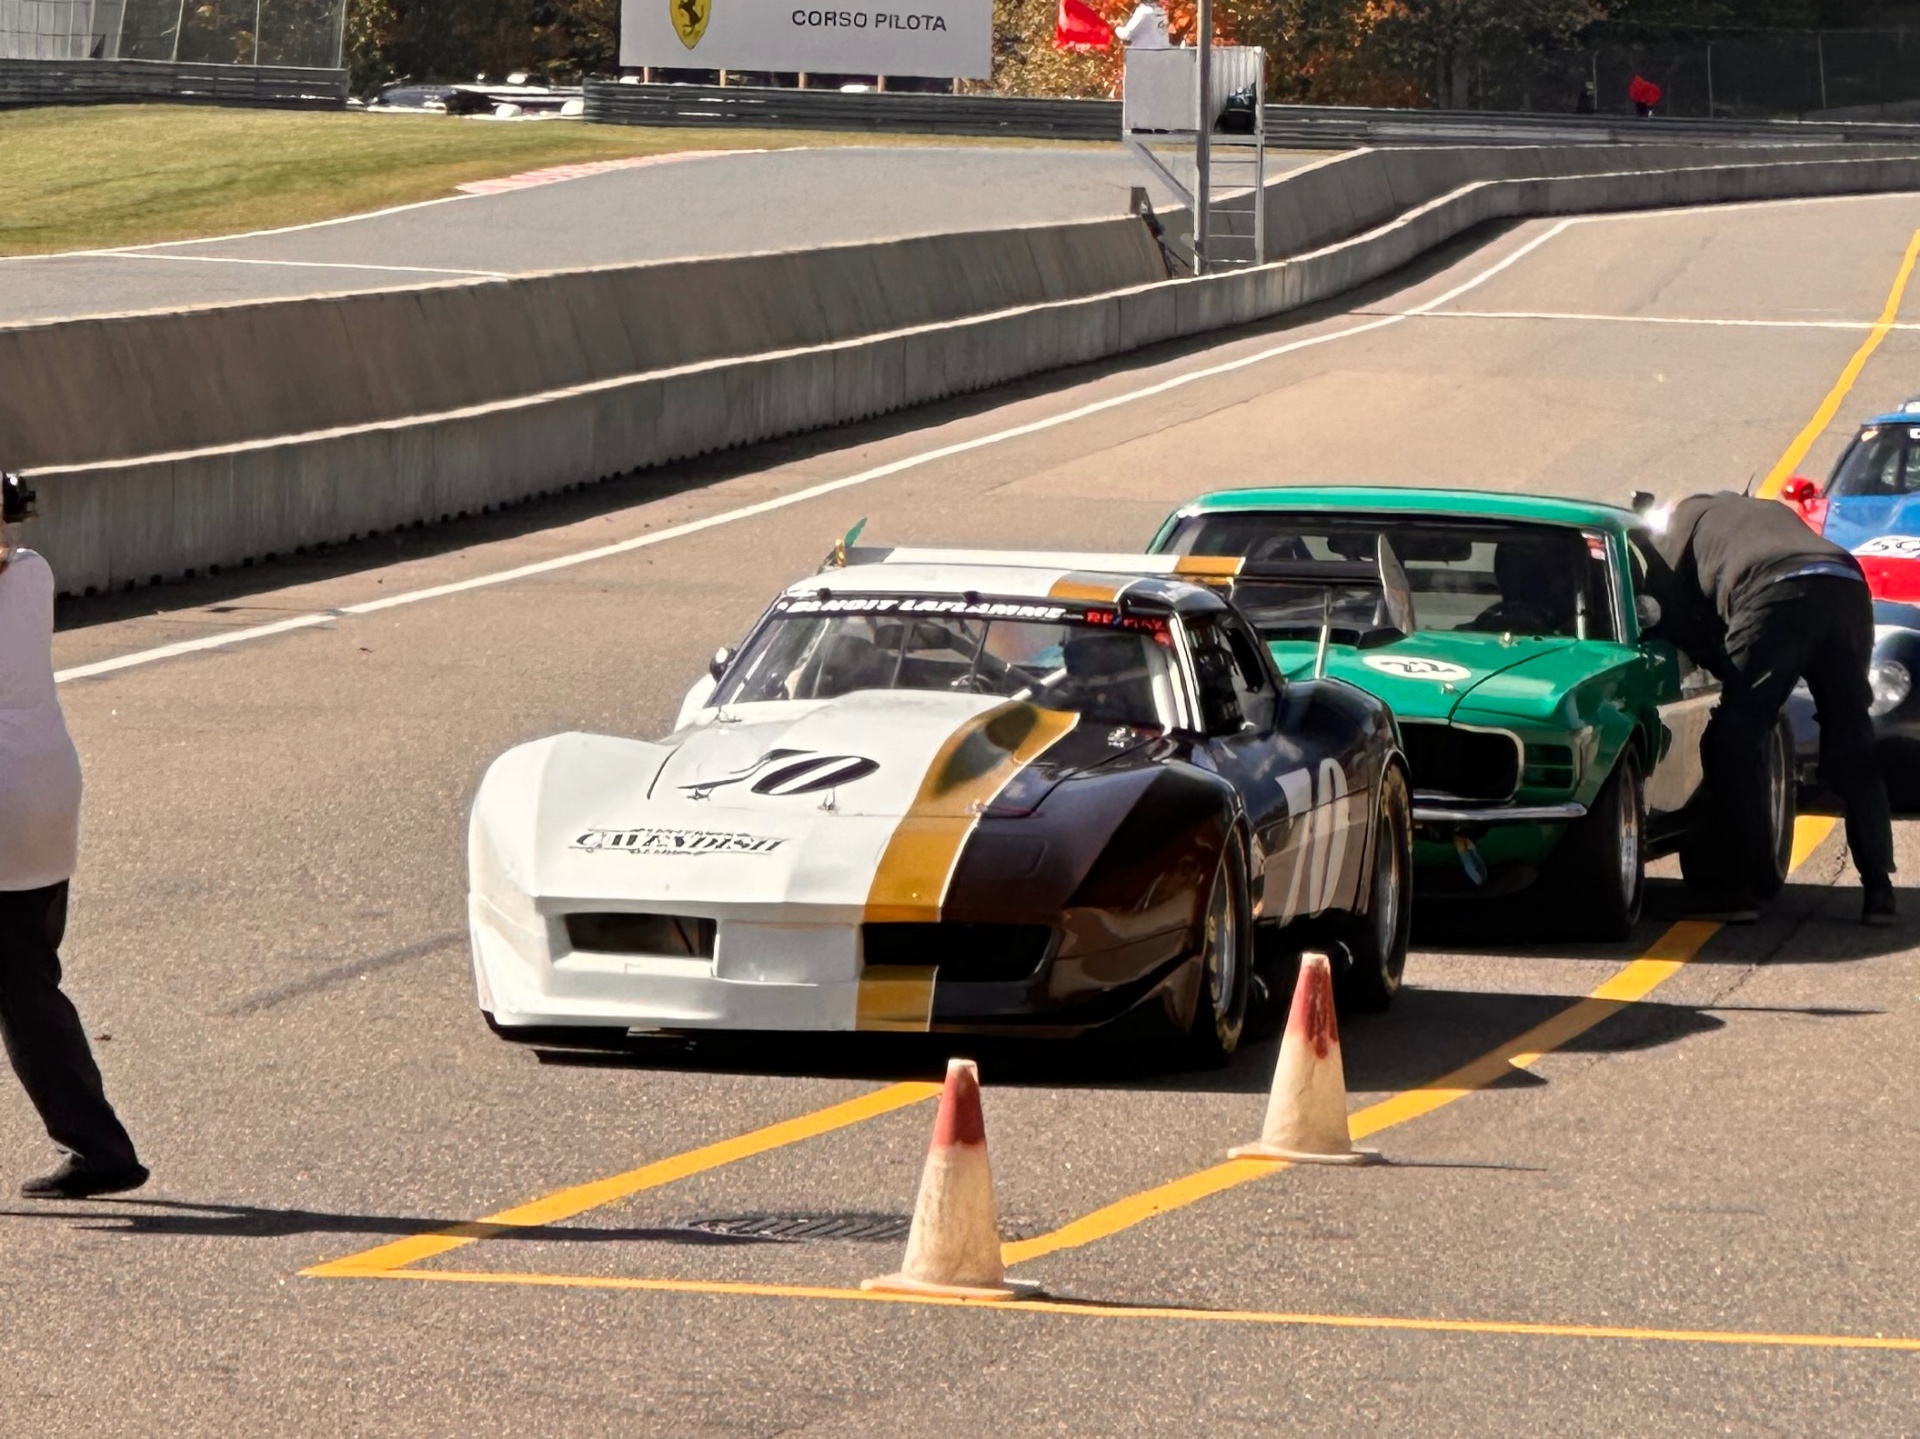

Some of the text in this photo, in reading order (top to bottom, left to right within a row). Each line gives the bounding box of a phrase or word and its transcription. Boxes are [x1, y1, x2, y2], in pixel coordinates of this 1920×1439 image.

[792, 10, 947, 31] CORSO PILOTA
[1275, 757, 1350, 928] 70
